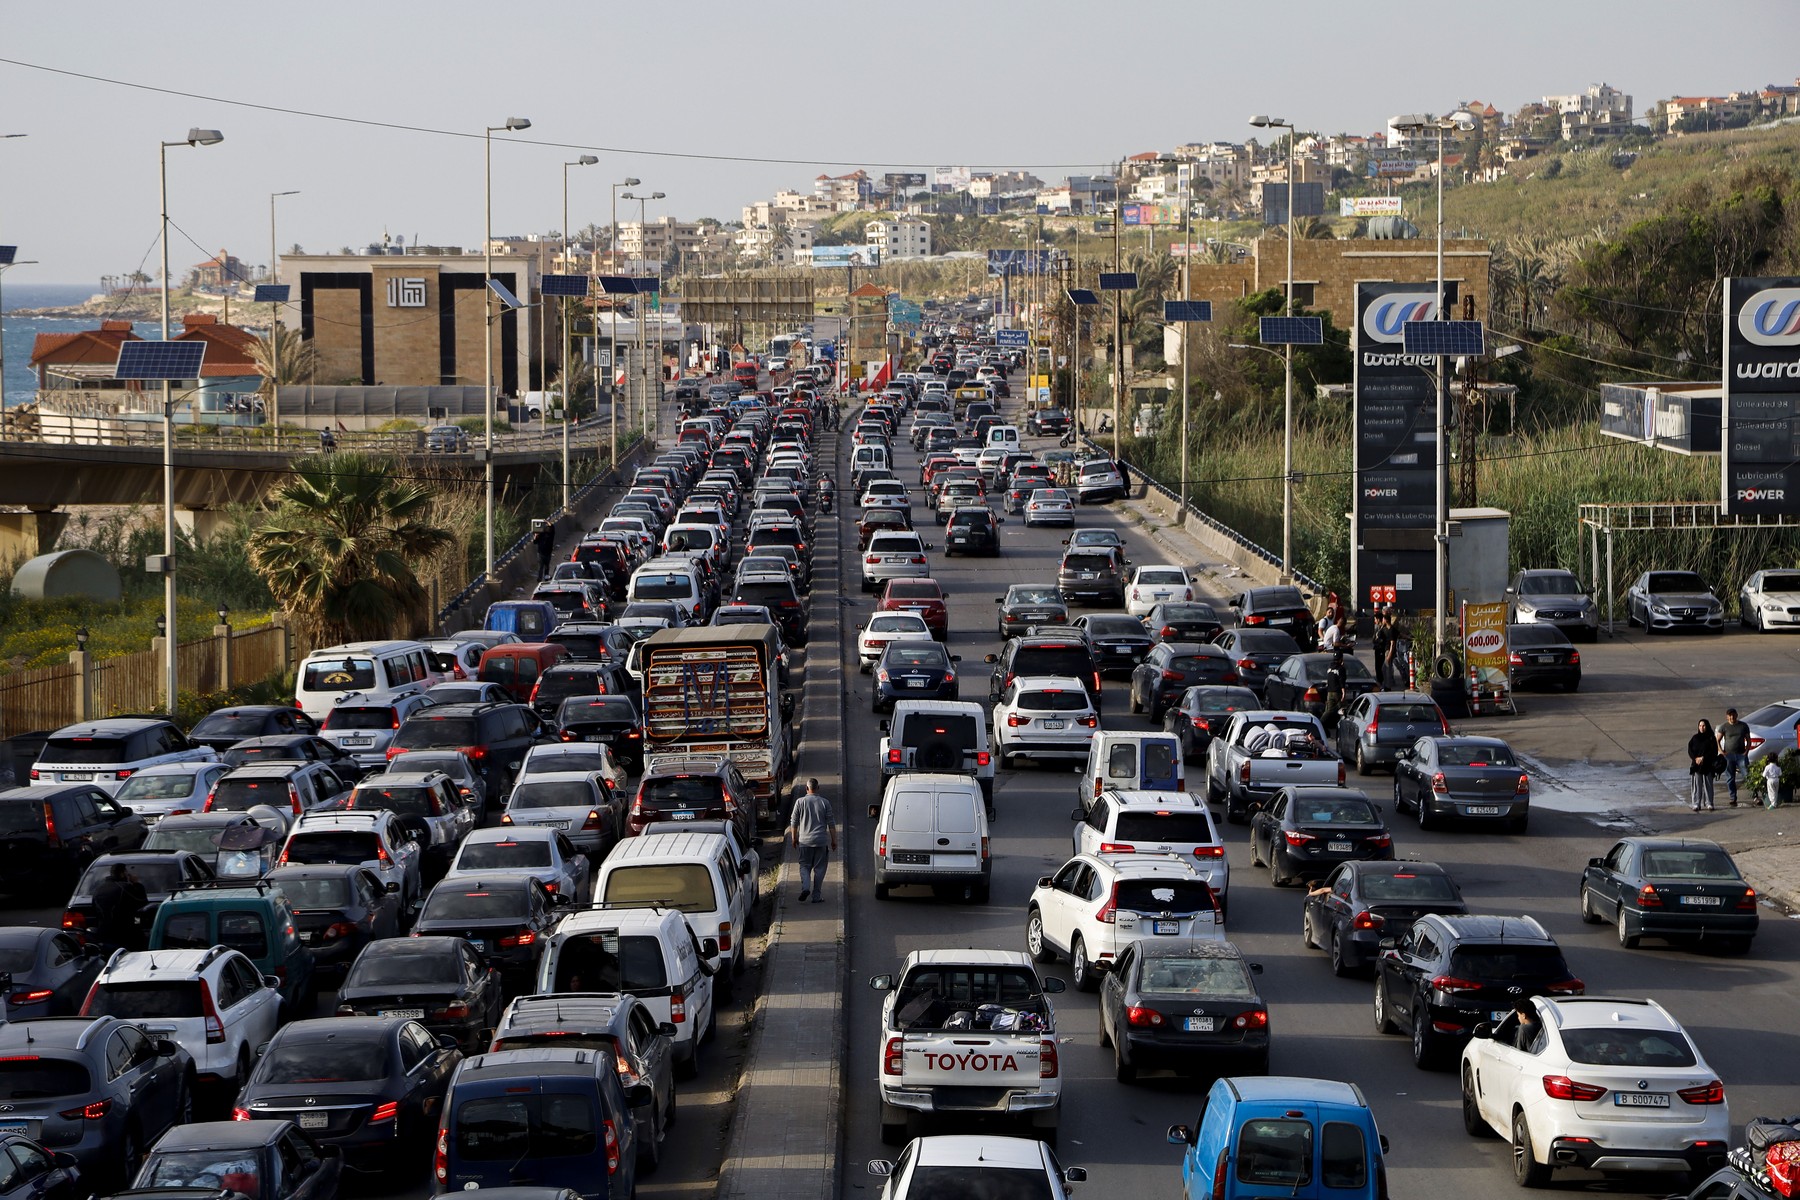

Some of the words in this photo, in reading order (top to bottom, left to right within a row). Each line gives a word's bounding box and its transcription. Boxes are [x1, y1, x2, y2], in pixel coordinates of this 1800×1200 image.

[1736, 400, 1775, 408] Unleaded
[1735, 443, 1760, 451] Diesel
[1736, 472, 1784, 480] Lubricants
[1364, 488, 1397, 497] POWER
[1737, 490, 1785, 500] POWER
[1471, 605, 1501, 617] غسيل
[1469, 617, 1503, 629] سيارات
[1468, 634, 1499, 647] 400,000
[1467, 658, 1483, 666] CAR
[1484, 656, 1507, 665] WASH
[1496, 1012, 1502, 1020] S
[924, 1053, 1018, 1071] TOYOTA
[1621, 1094, 1628, 1103] B
[1632, 1094, 1664, 1105] 600747
